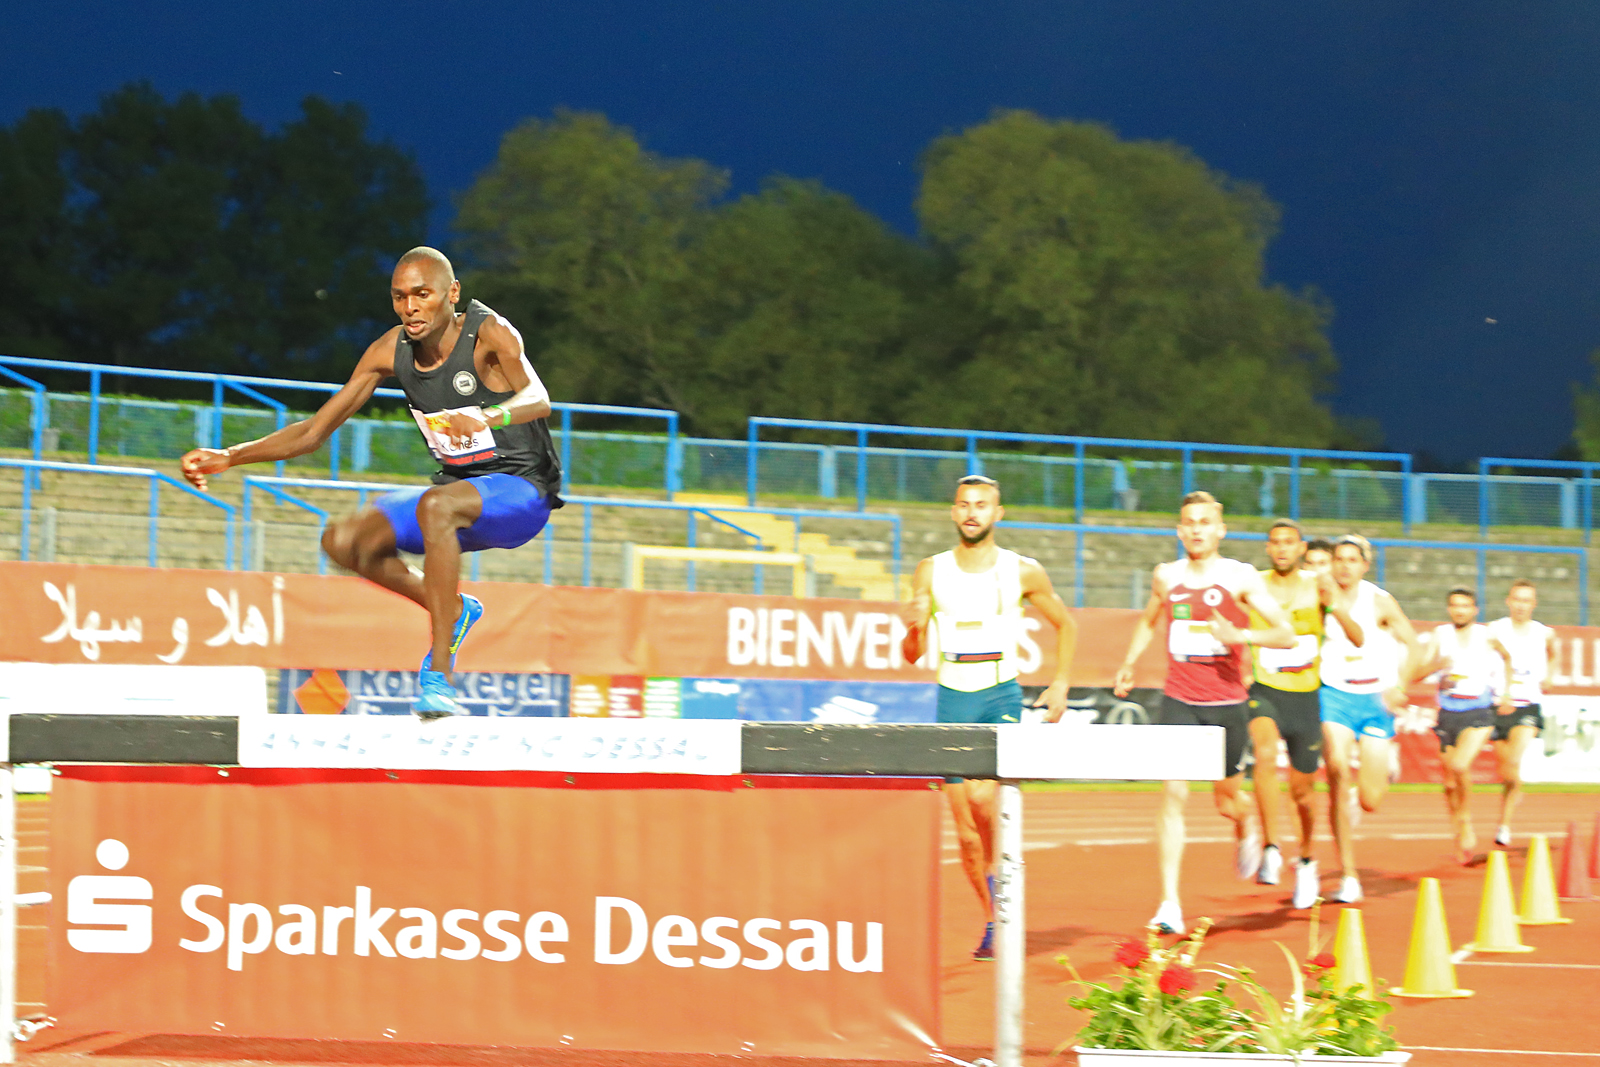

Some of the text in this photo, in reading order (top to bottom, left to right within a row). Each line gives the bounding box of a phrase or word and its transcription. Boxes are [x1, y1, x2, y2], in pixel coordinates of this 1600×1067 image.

[40, 575, 285, 663] أهلا و سهلا
[728, 607, 1042, 674] BIENVENIS
[580, 734, 711, 762] DESSA
[178, 883, 884, 974] Sparkasse Dessau
